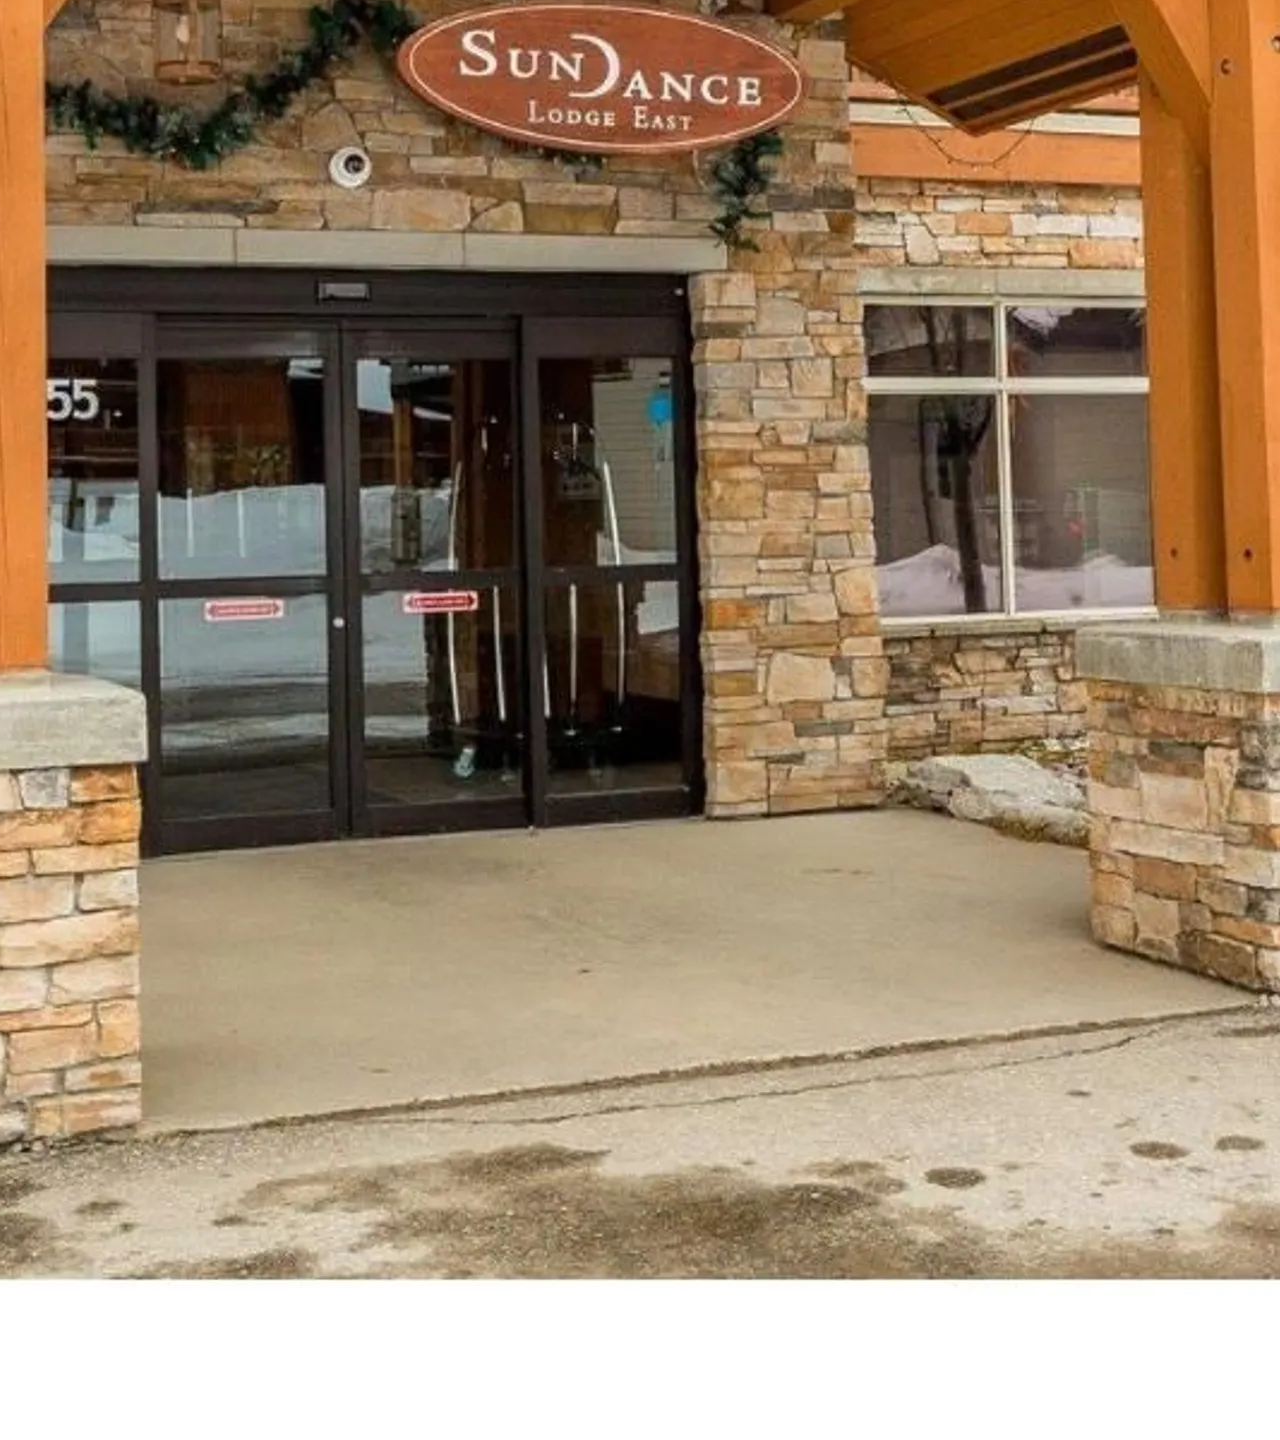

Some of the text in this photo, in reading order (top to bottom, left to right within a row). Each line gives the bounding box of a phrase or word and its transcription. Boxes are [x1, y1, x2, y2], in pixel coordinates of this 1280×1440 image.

[527, 99, 693, 131] LODGE EAST
[47, 378, 100, 420] 55
